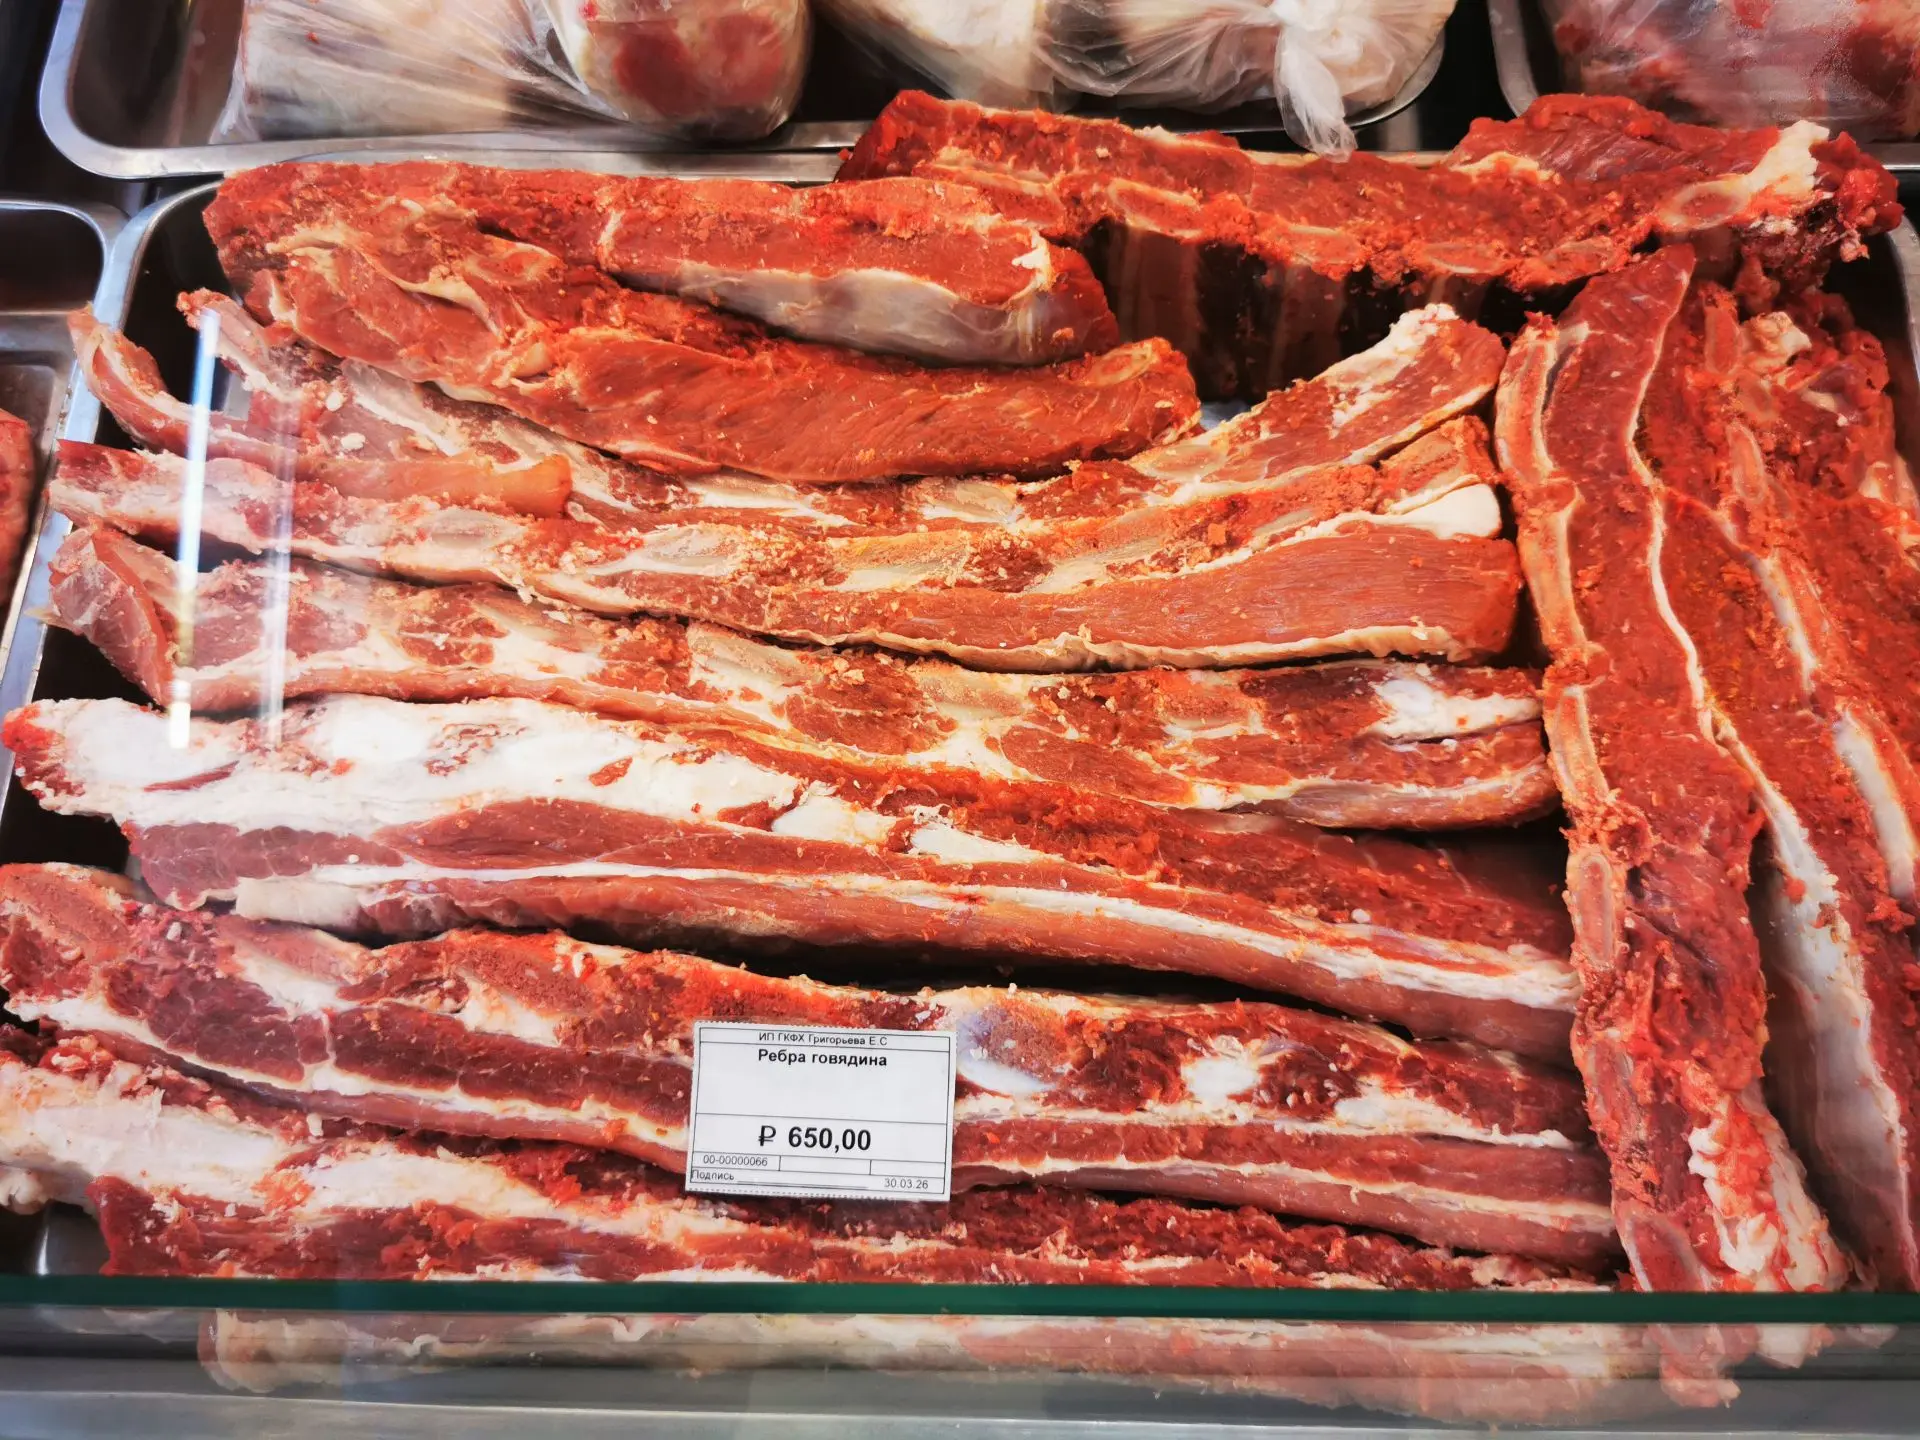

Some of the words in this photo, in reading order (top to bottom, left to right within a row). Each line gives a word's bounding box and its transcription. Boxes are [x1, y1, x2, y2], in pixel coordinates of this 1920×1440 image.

[759, 1032, 775, 1042] ИП
[778, 1032, 805, 1043] ГКФХ
[808, 1033, 866, 1046] Григорьева
[758, 1049, 806, 1066] Ребра
[812, 1053, 888, 1067] говядина
[758, 1125, 777, 1147] ₽
[788, 1126, 872, 1153] 650,00
[703, 1155, 768, 1167] 00-00000066
[691, 1169, 735, 1182] Подпись
[884, 1178, 929, 1190] 30.03.26
